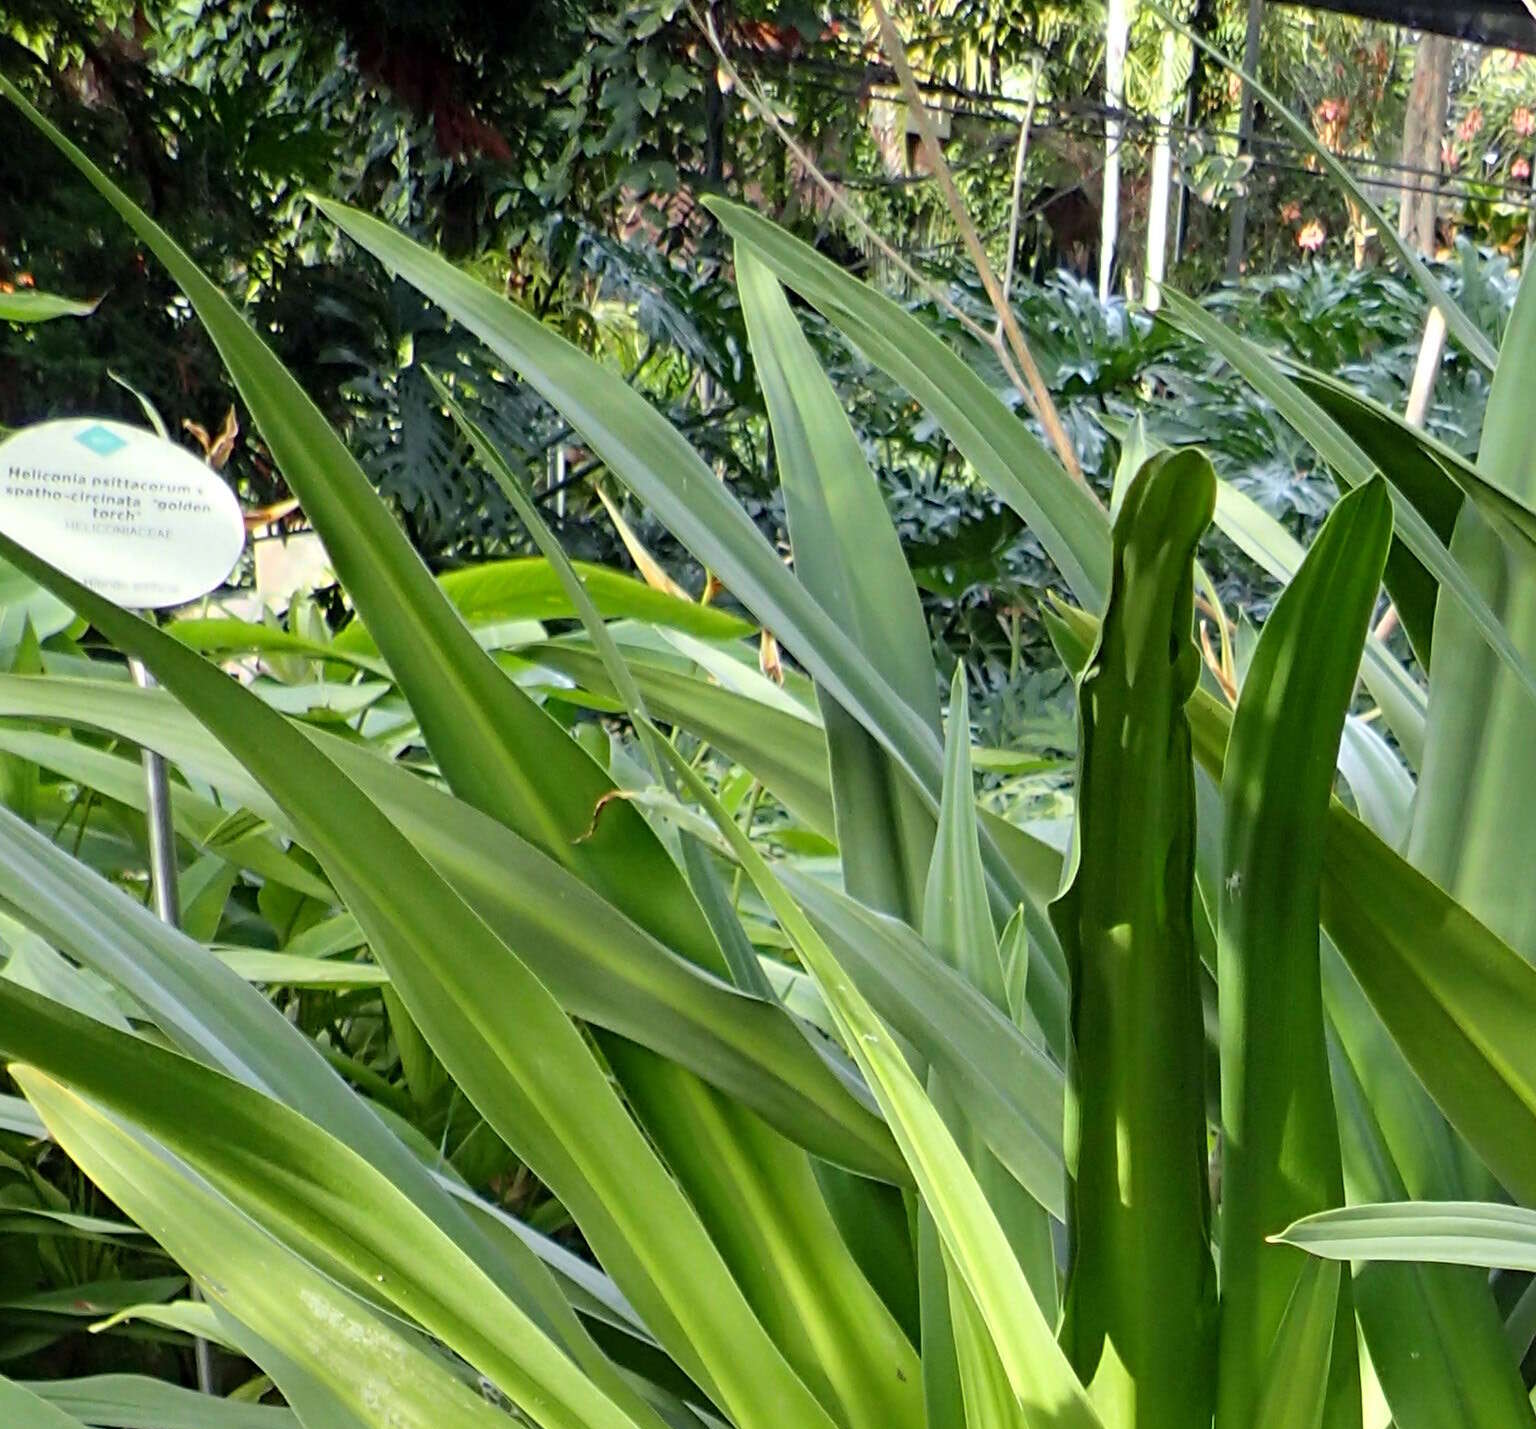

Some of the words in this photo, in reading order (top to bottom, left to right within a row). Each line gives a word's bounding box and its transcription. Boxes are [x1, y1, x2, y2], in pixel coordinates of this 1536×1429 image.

[8, 466, 87, 485] Heliconia
[91, 476, 191, 495] psittacorum
[5, 486, 141, 507] spatho-circinata
